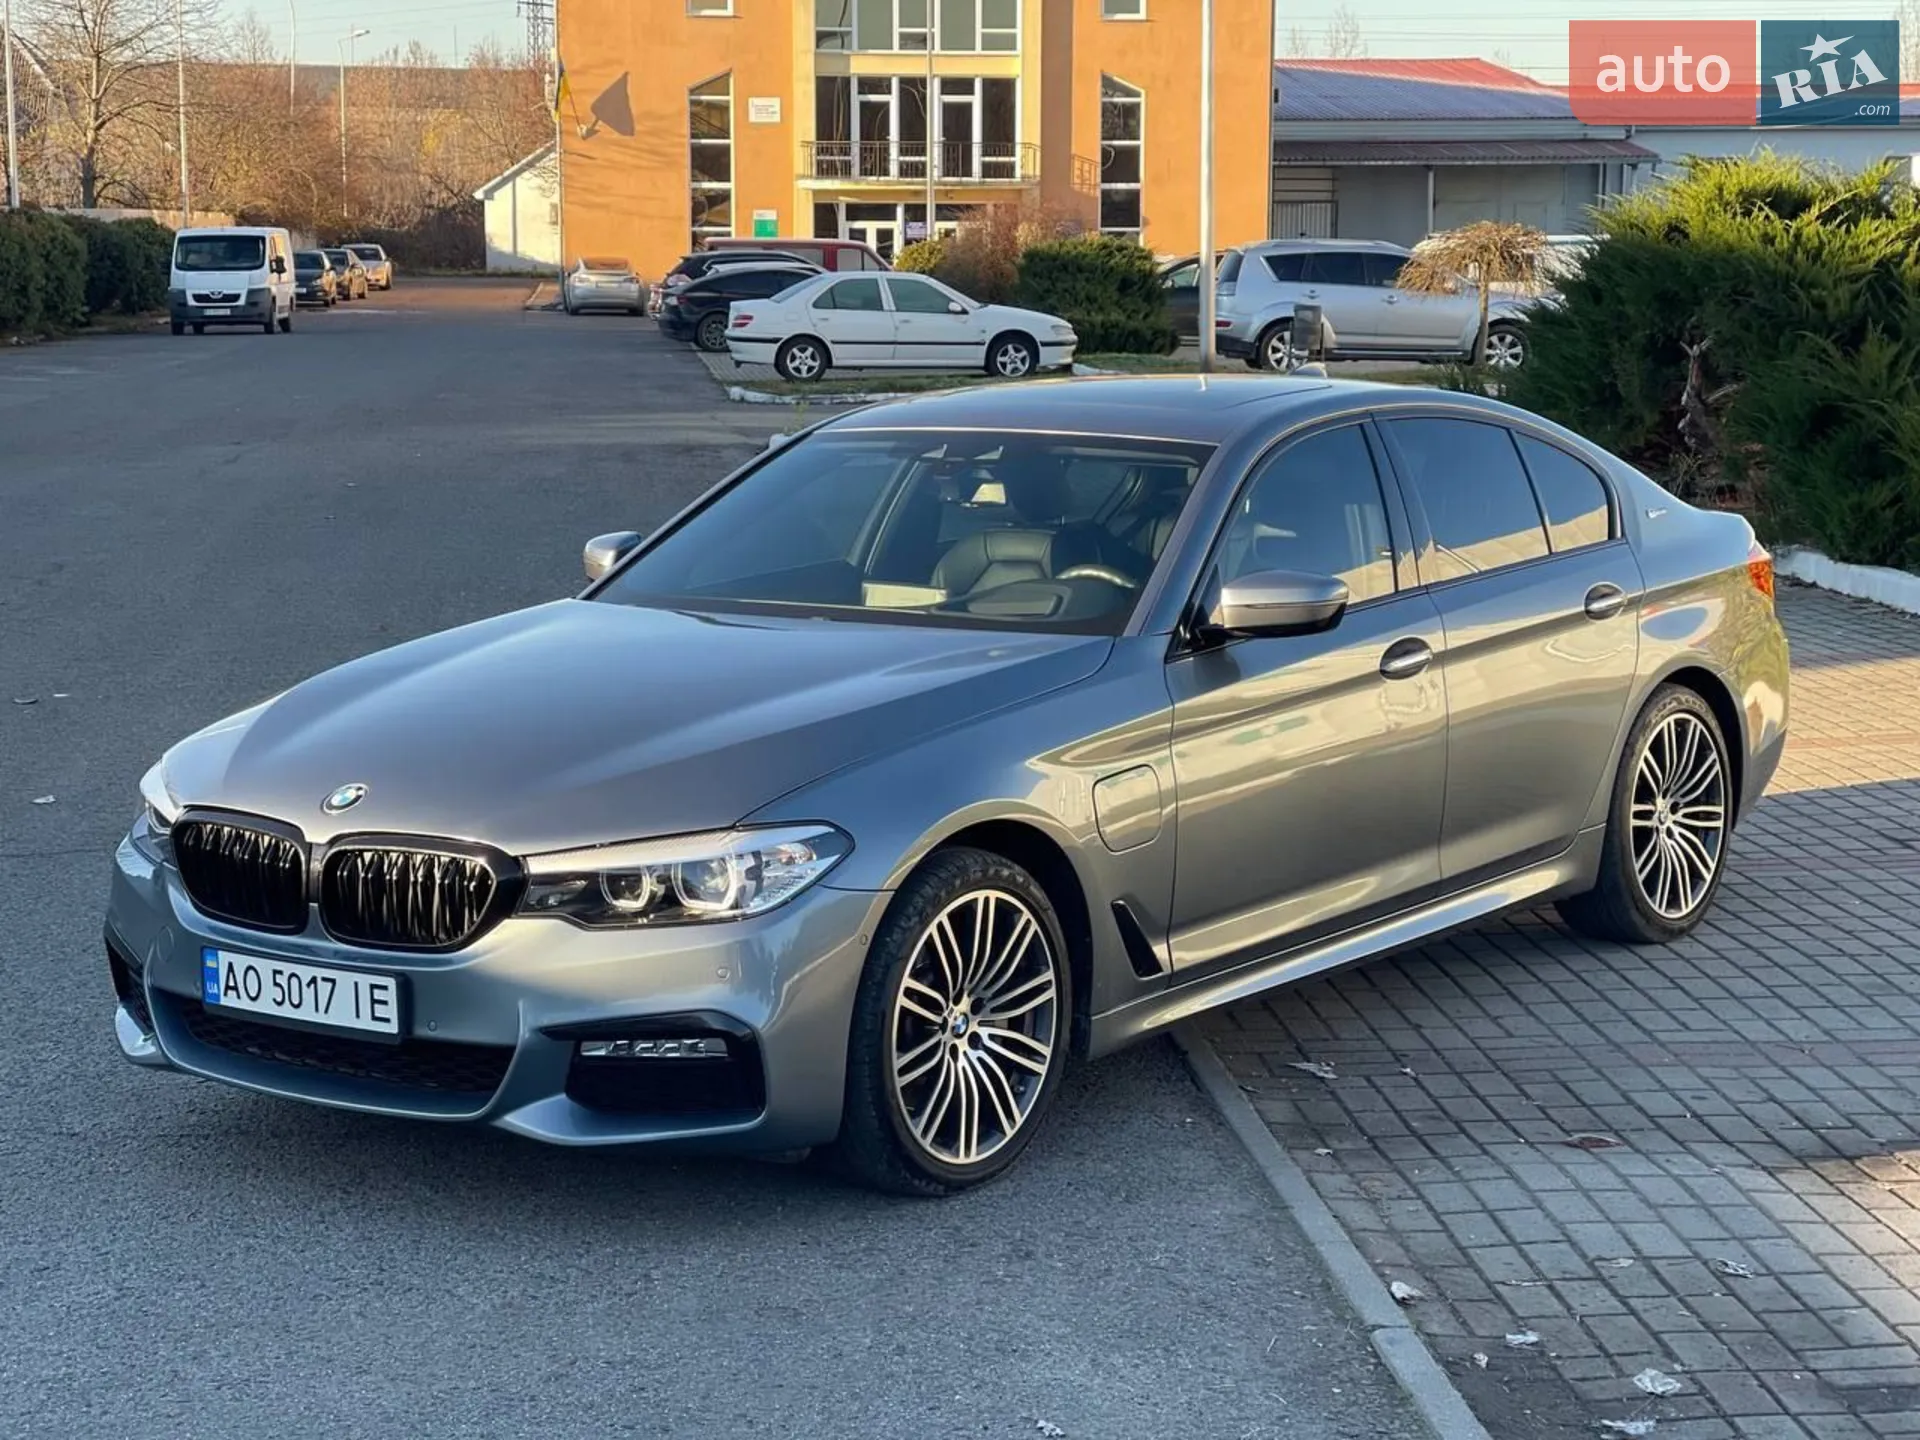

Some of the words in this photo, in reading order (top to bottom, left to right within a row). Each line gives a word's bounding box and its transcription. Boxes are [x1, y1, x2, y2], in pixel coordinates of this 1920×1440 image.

[206, 981, 218, 995] UA
[223, 961, 262, 1002] AO
[272, 969, 337, 1015] 5017
[354, 980, 391, 1024] IE
